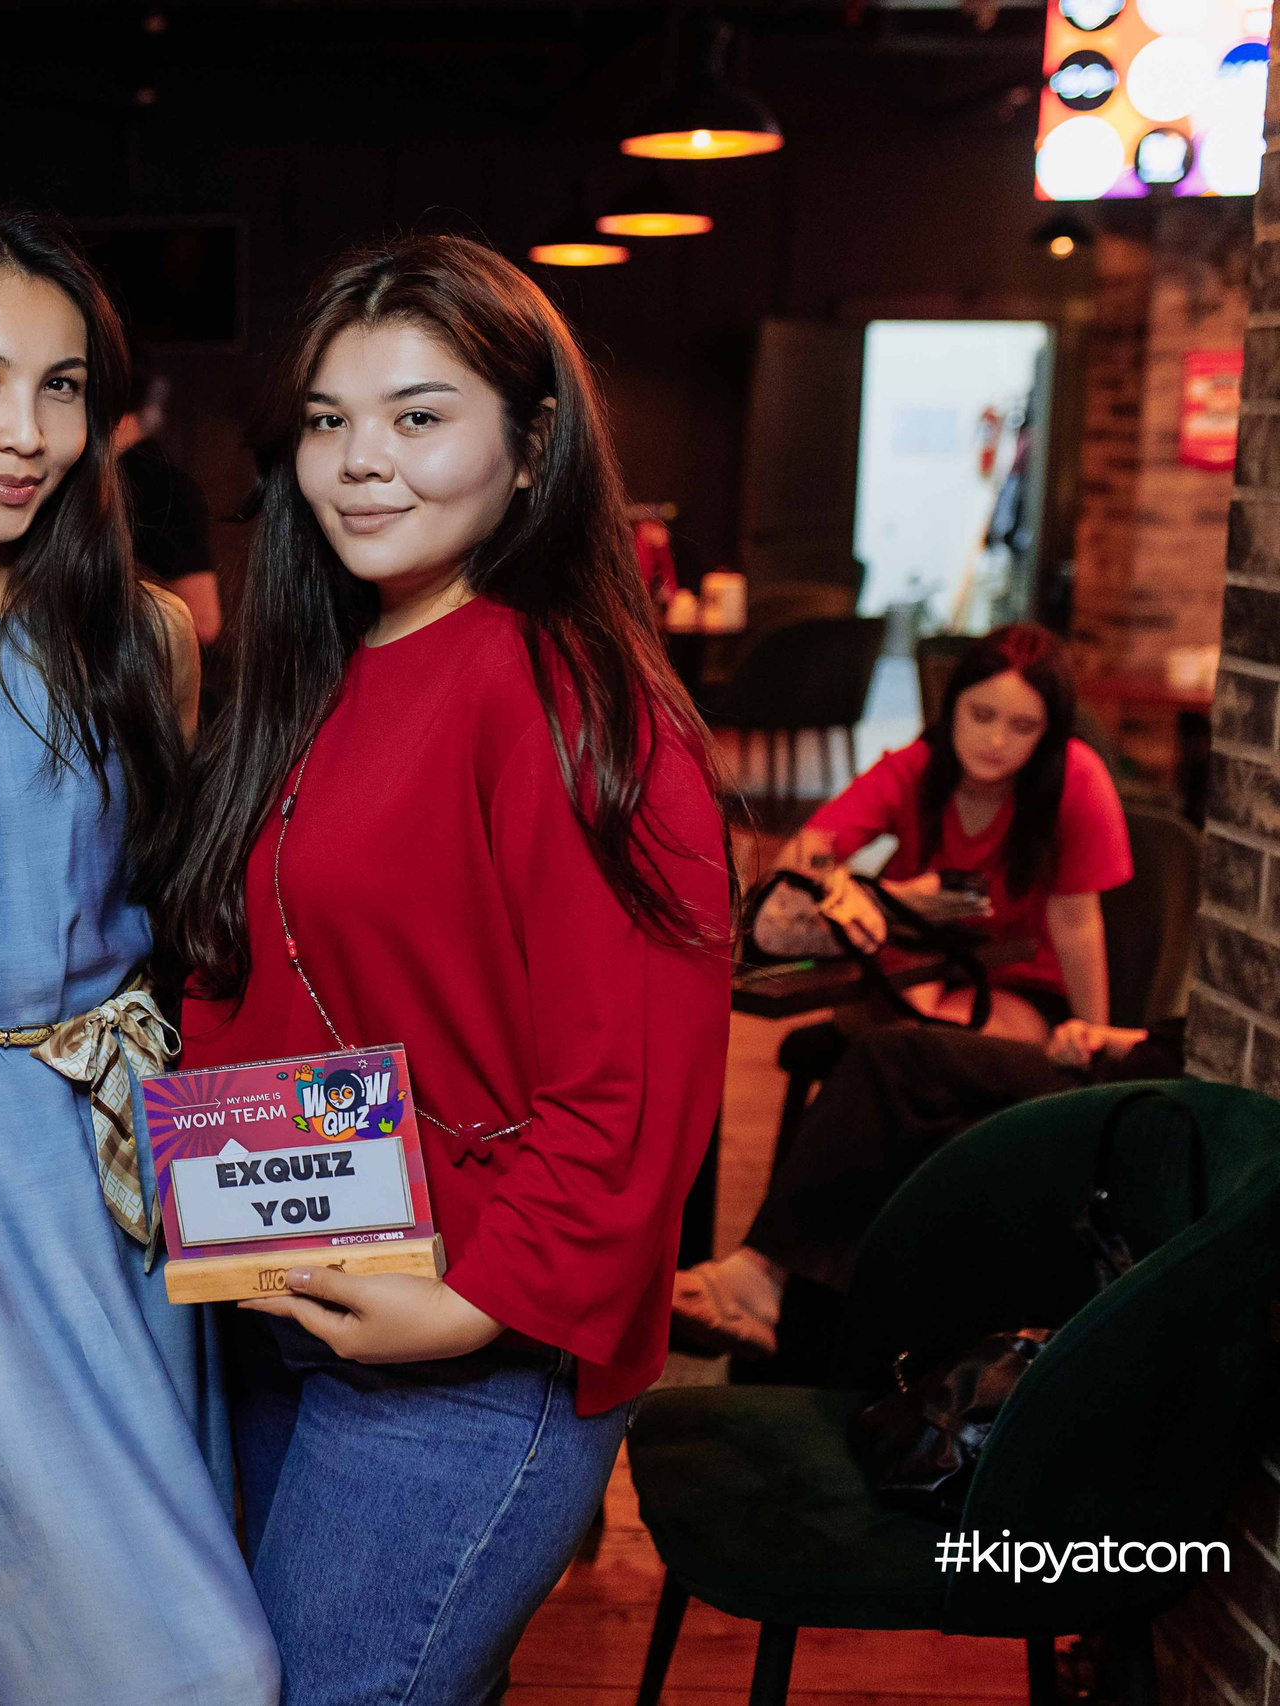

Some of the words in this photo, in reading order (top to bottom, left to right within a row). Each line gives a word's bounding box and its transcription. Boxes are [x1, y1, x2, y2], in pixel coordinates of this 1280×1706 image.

[226, 1097, 240, 1105] MY
[242, 1093, 270, 1104] NAME
[272, 1092, 281, 1101] IS
[173, 1110, 226, 1130] WOW
[231, 1104, 287, 1123] TEAM
[322, 1104, 370, 1137] QUIZ
[215, 1150, 356, 1189] EXQUIZ
[251, 1195, 331, 1227] YOU
[258, 1267, 293, 1292] WO
